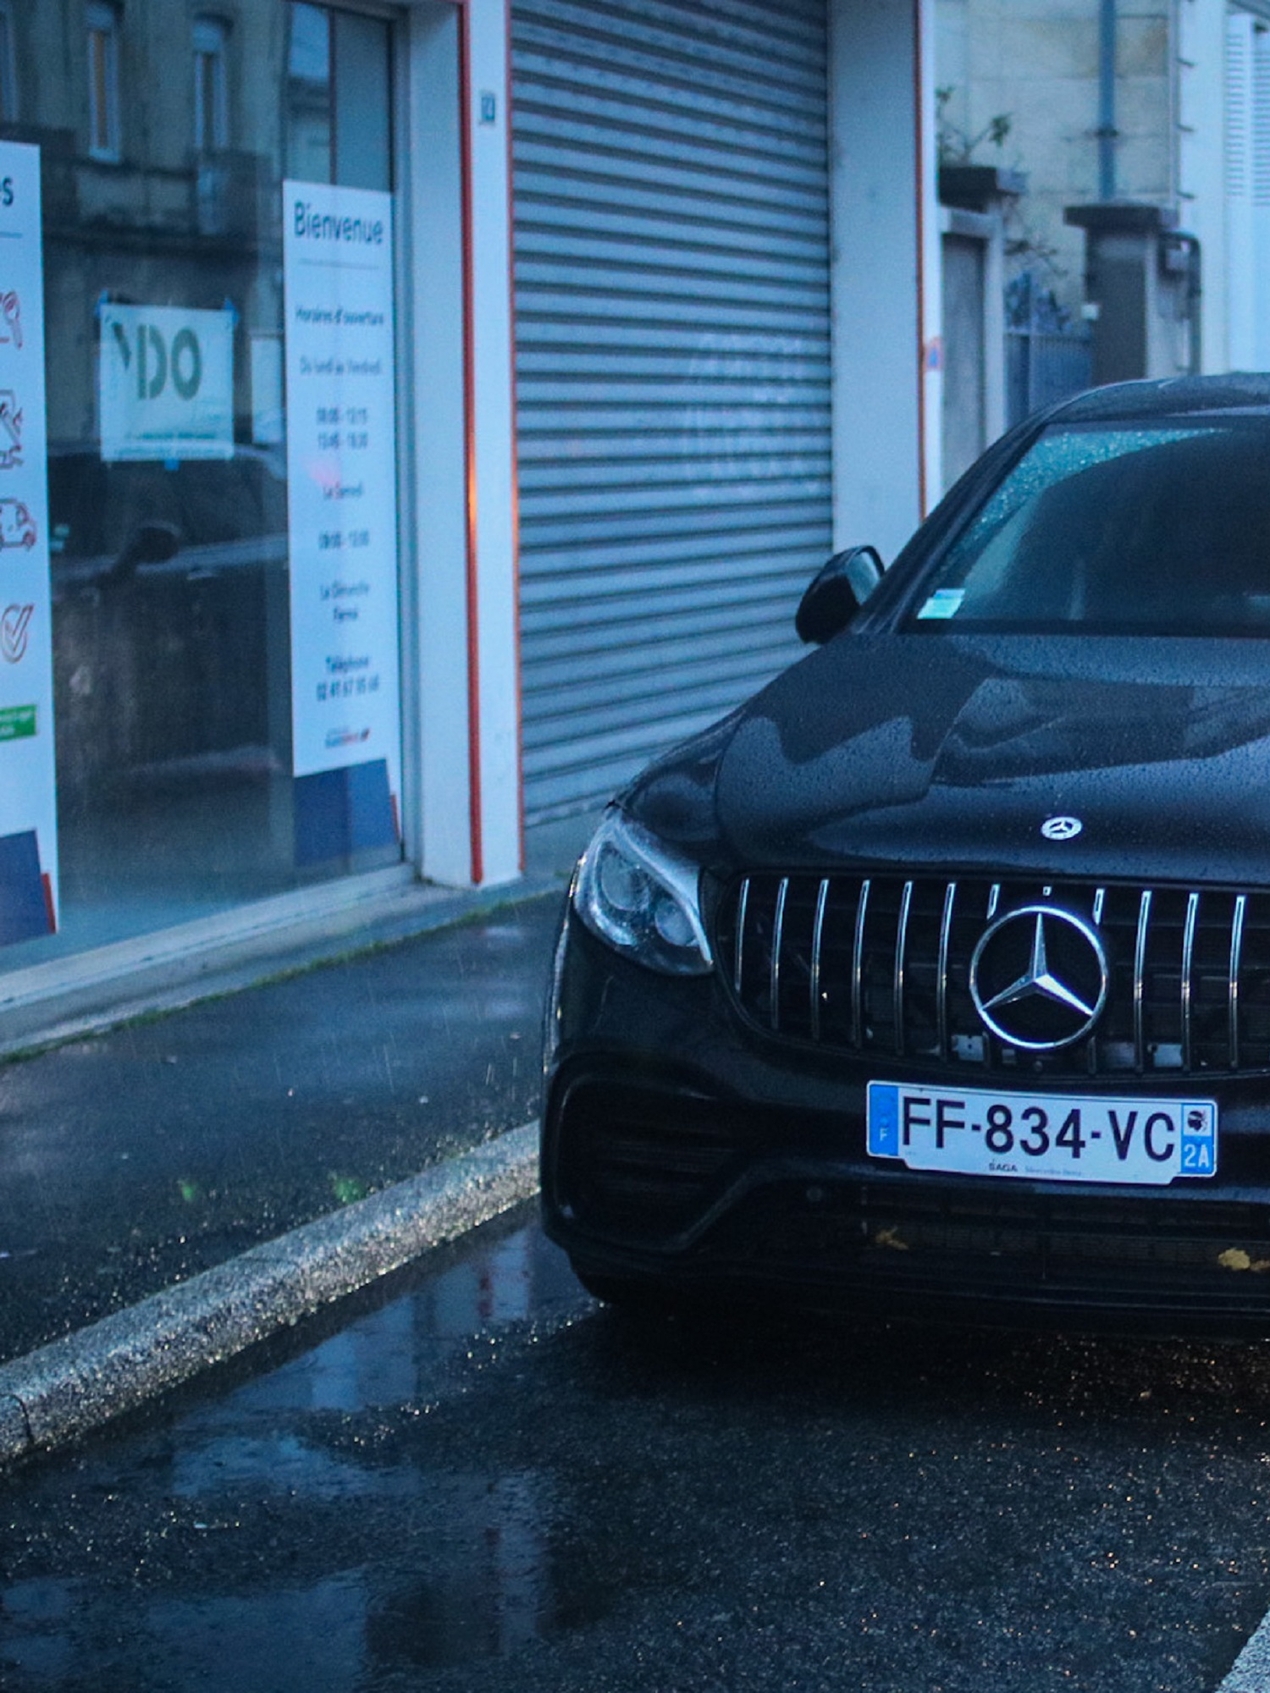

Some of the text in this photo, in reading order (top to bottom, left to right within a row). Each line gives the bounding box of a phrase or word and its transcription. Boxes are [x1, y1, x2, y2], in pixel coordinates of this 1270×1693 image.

[294, 201, 384, 246] Bienvenue
[880, 1128, 888, 1142] F
[903, 1096, 1175, 1163] FF-834-VC
[1184, 1143, 1210, 1168] 2A
